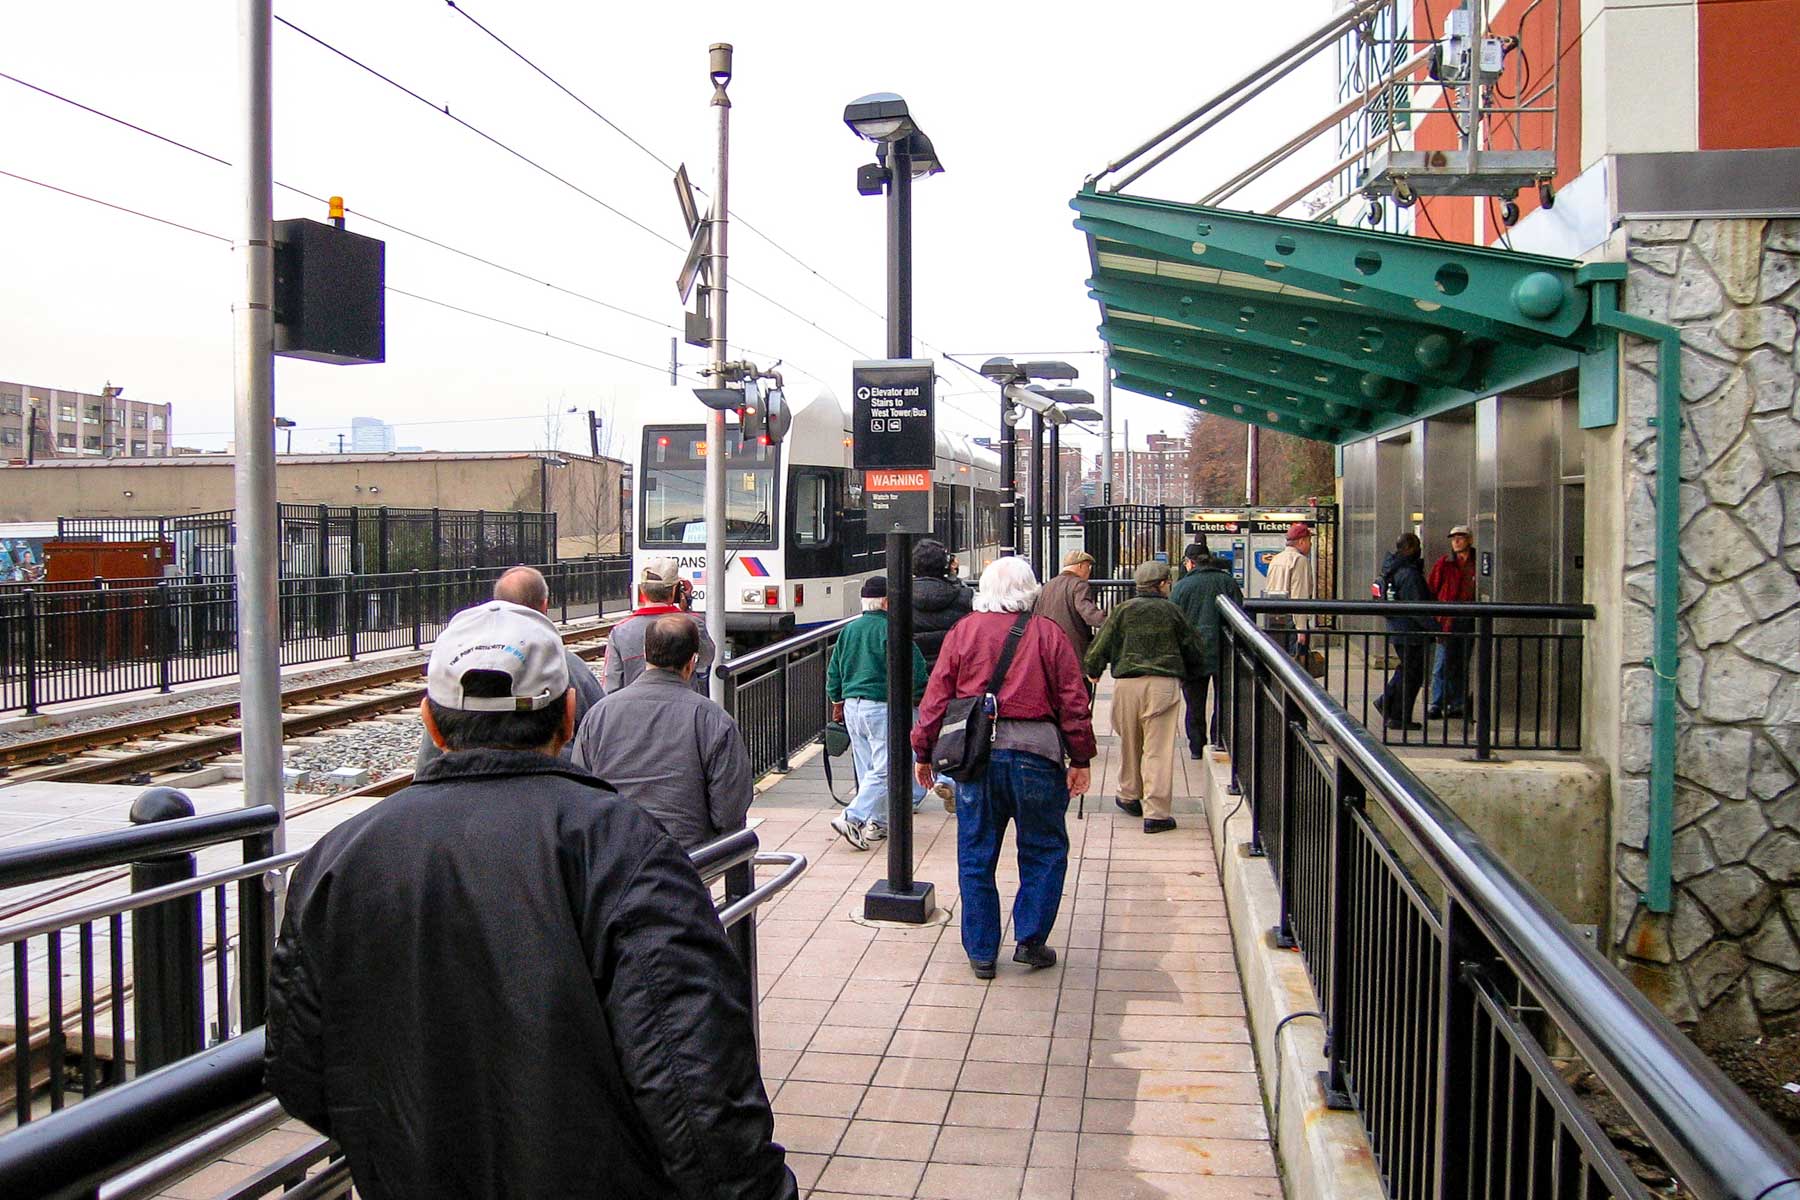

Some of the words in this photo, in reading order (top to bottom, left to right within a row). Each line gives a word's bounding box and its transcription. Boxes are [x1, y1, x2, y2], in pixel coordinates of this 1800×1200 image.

[871, 387, 902, 396] Elevator
[904, 387, 919, 396] and
[871, 398, 893, 407] Stairs
[895, 398, 903, 407] to
[871, 408, 889, 417] West
[872, 474, 924, 486] WARNING
[1192, 522, 1225, 531] Tickets
[1257, 522, 1291, 531] Tickets
[449, 656, 460, 666] THE
[460, 647, 474, 657] PORT
